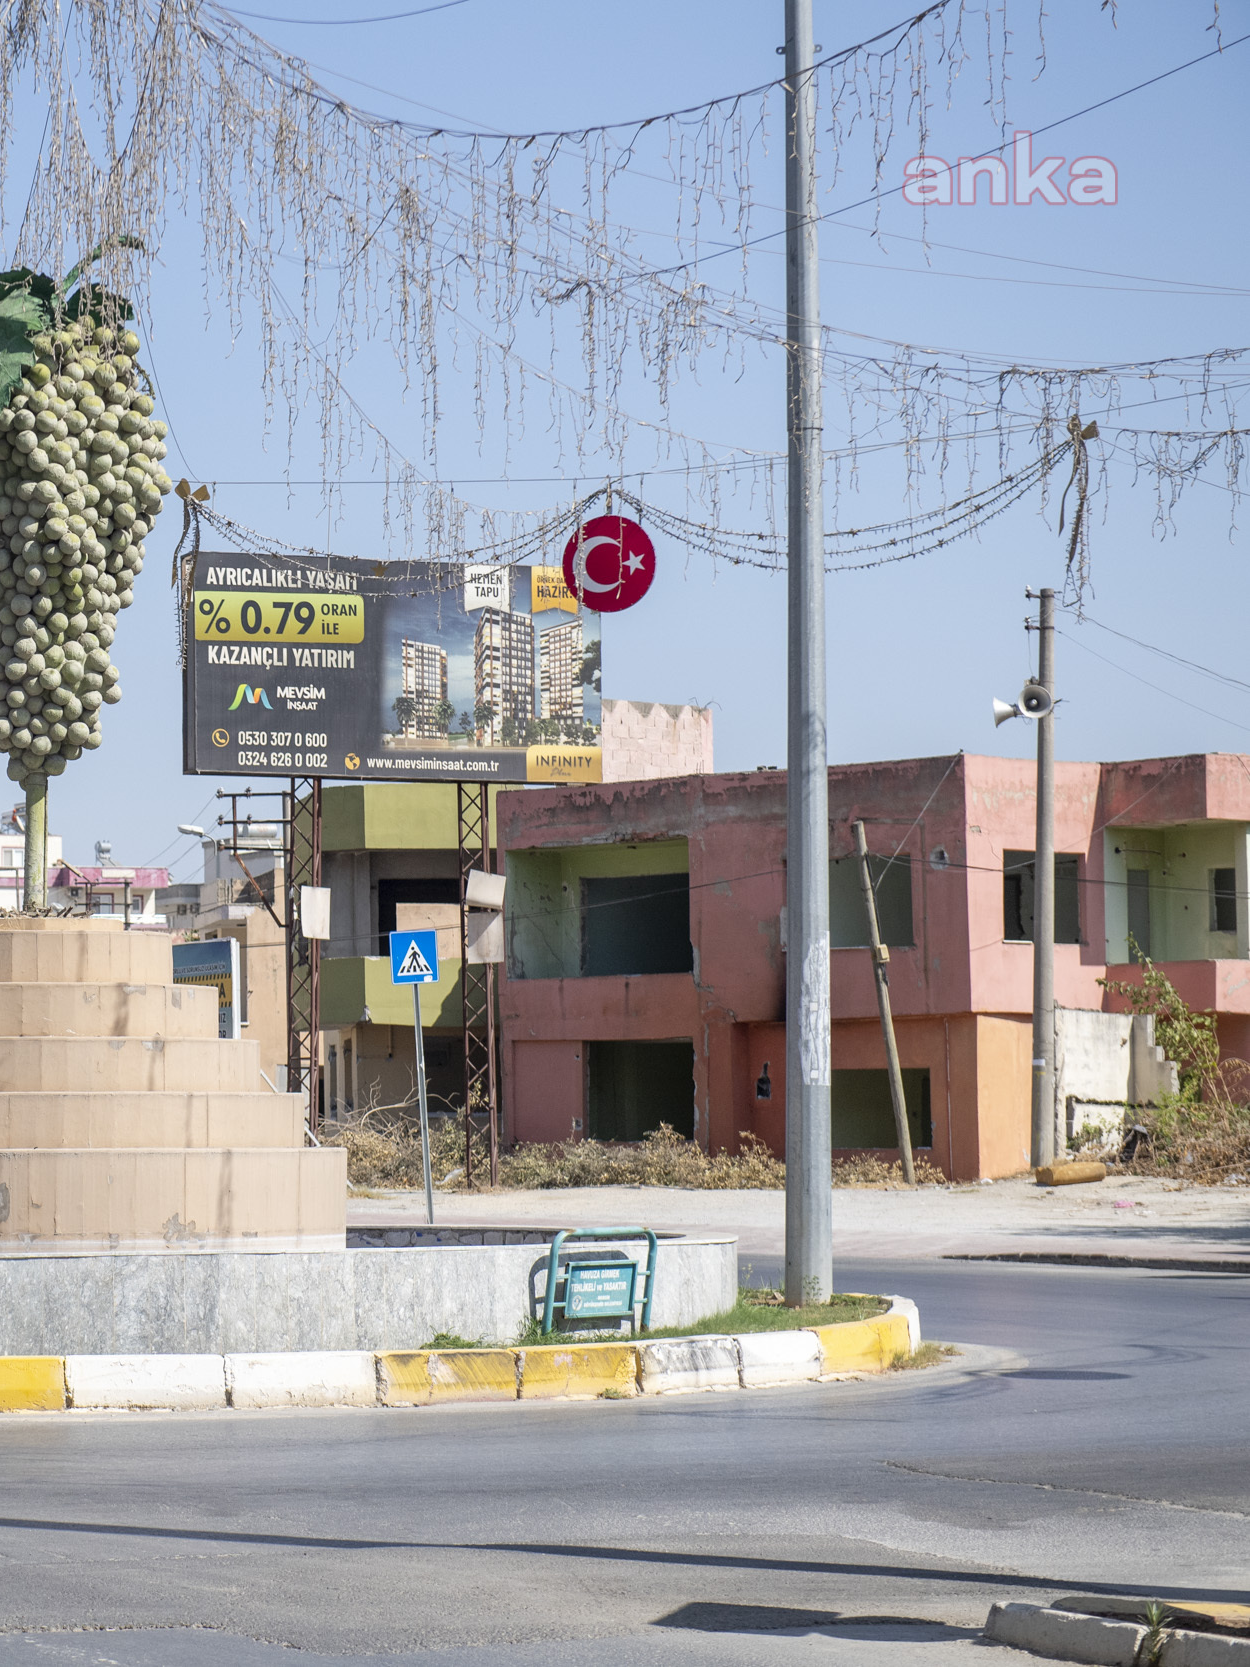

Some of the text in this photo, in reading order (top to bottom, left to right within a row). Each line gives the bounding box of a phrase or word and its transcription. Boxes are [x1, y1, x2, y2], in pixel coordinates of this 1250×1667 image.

[206, 566, 357, 593] AYRICALIKLI YAŞAM
[470, 573, 502, 585] HEMEN
[475, 586, 499, 598] TAPU
[199, 599, 315, 634] % 0.79
[321, 603, 358, 616] ORAN
[321, 619, 340, 635] İLE
[208, 645, 355, 670] KAZANÇLI YATIRIM
[276, 684, 326, 700] MEVSİM
[287, 699, 318, 711] İNŞAAT
[238, 731, 328, 748] 0530 307 0 600
[238, 751, 328, 768] 0324 626 0 002
[367, 757, 499, 772] www.mevsiminsaat.com.tr
[536, 755, 592, 768] INFINITY
